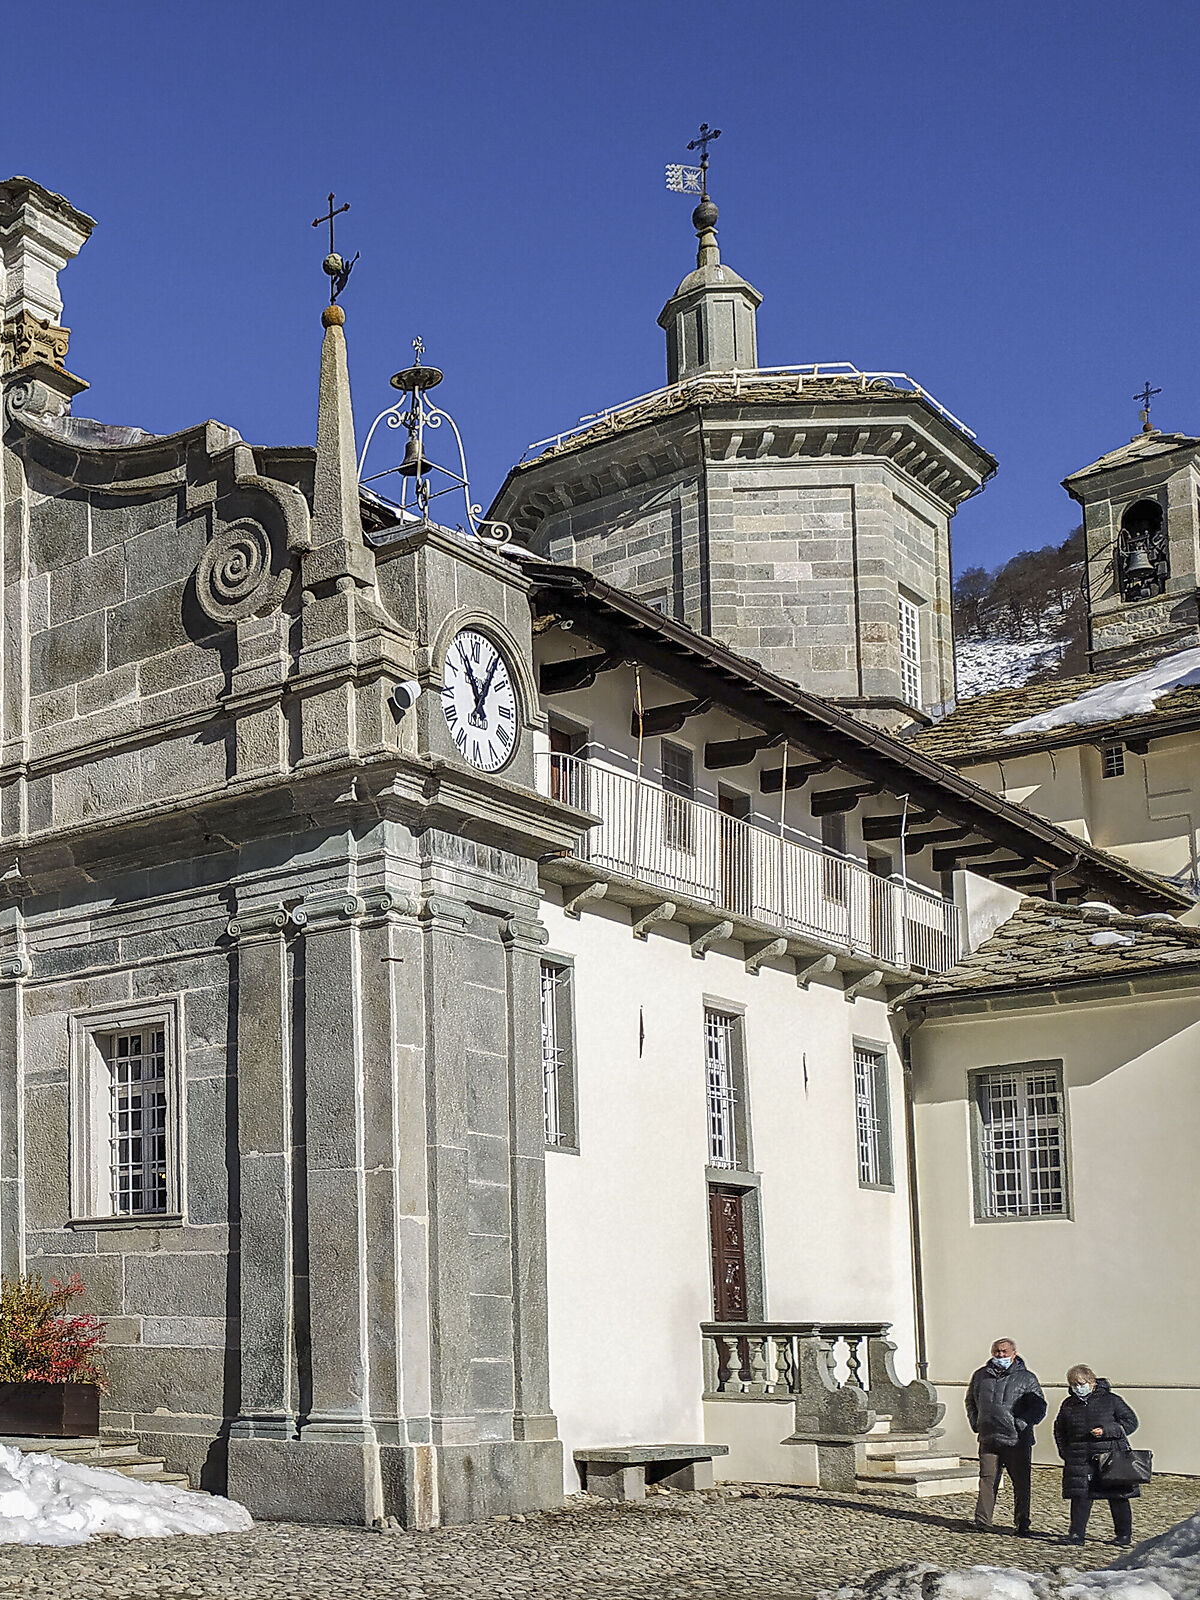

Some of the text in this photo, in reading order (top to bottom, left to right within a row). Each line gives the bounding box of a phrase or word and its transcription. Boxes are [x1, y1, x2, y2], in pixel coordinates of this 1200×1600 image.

[470, 640, 481, 664] XII
[445, 655, 458, 678] X
[441, 685, 455, 699] IX
[493, 680, 506, 693] II
[498, 705, 511, 720] III
[473, 739, 483, 764] VI
[488, 739, 499, 762] V
